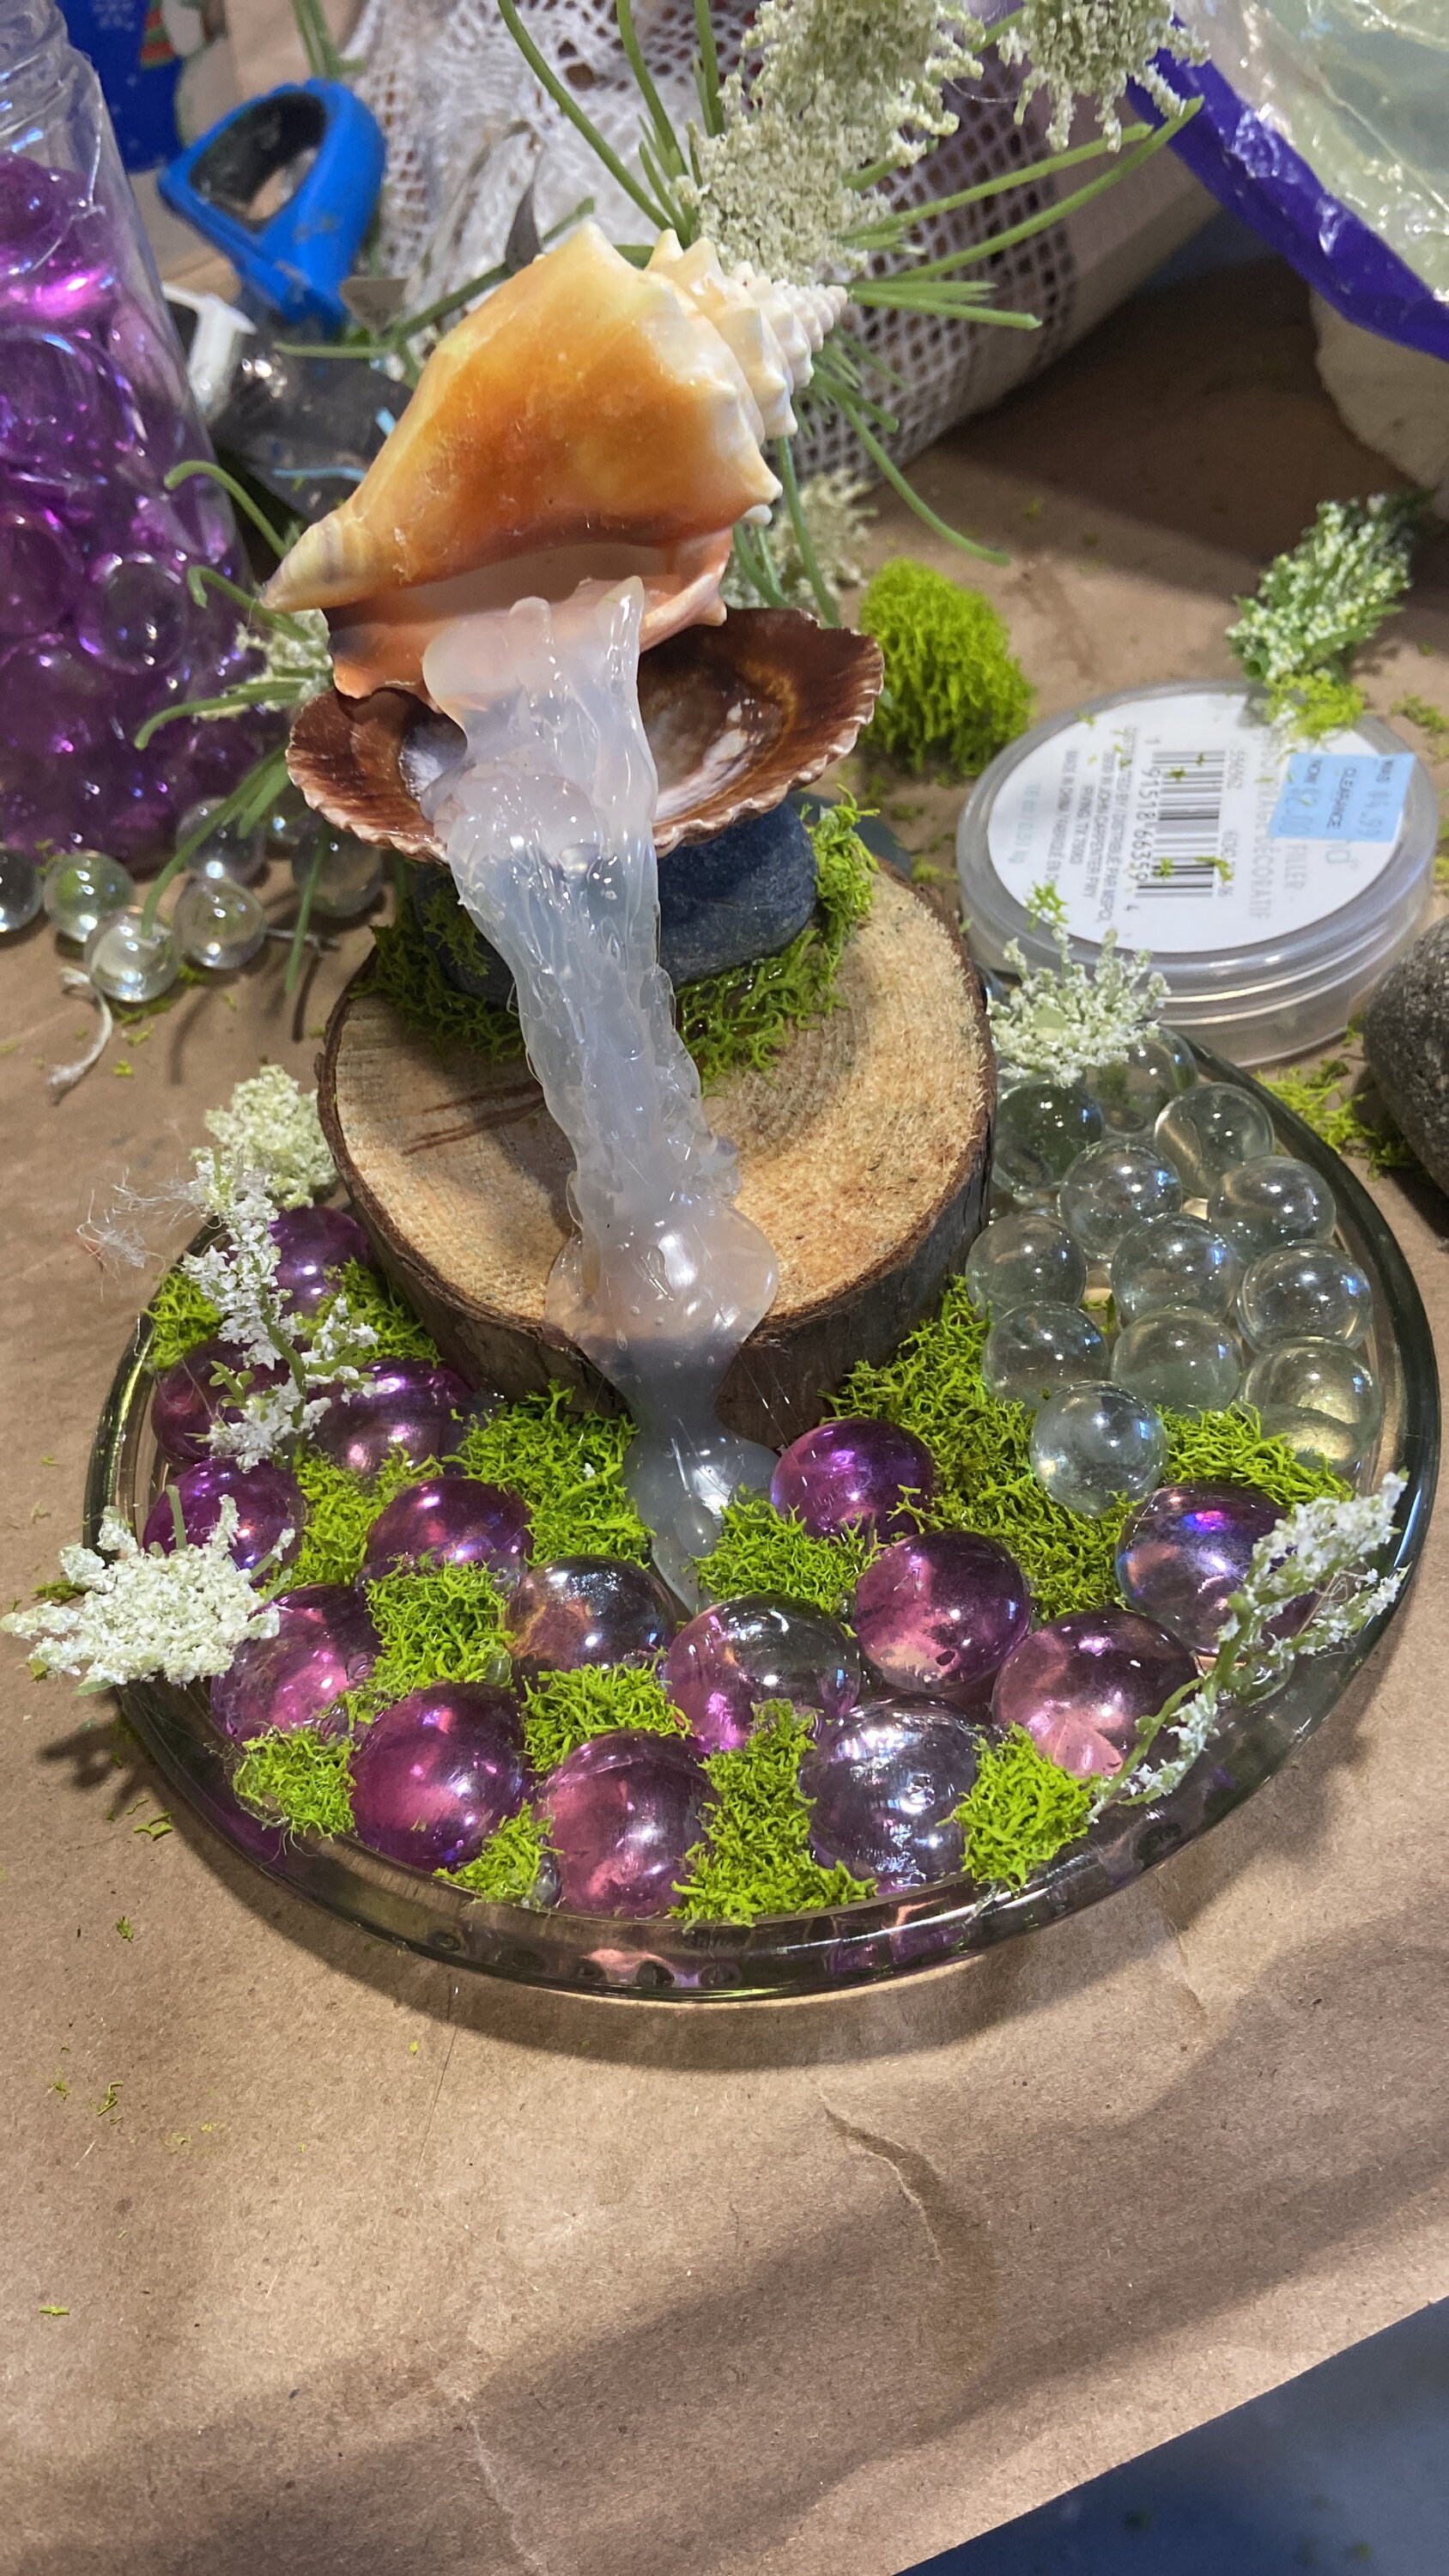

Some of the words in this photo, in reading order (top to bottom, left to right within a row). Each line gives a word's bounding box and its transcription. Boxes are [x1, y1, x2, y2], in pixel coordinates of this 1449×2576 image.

[1136, 767, 1161, 821] 91518
[1304, 759, 1324, 784] NOW
[1326, 767, 1357, 829] CLEARANCE
[1375, 759, 1394, 783] WAS
[1129, 829, 1155, 883] 66359
[1249, 836, 1281, 920] DÉCORATIF
[1284, 844, 1307, 890] FILLER
